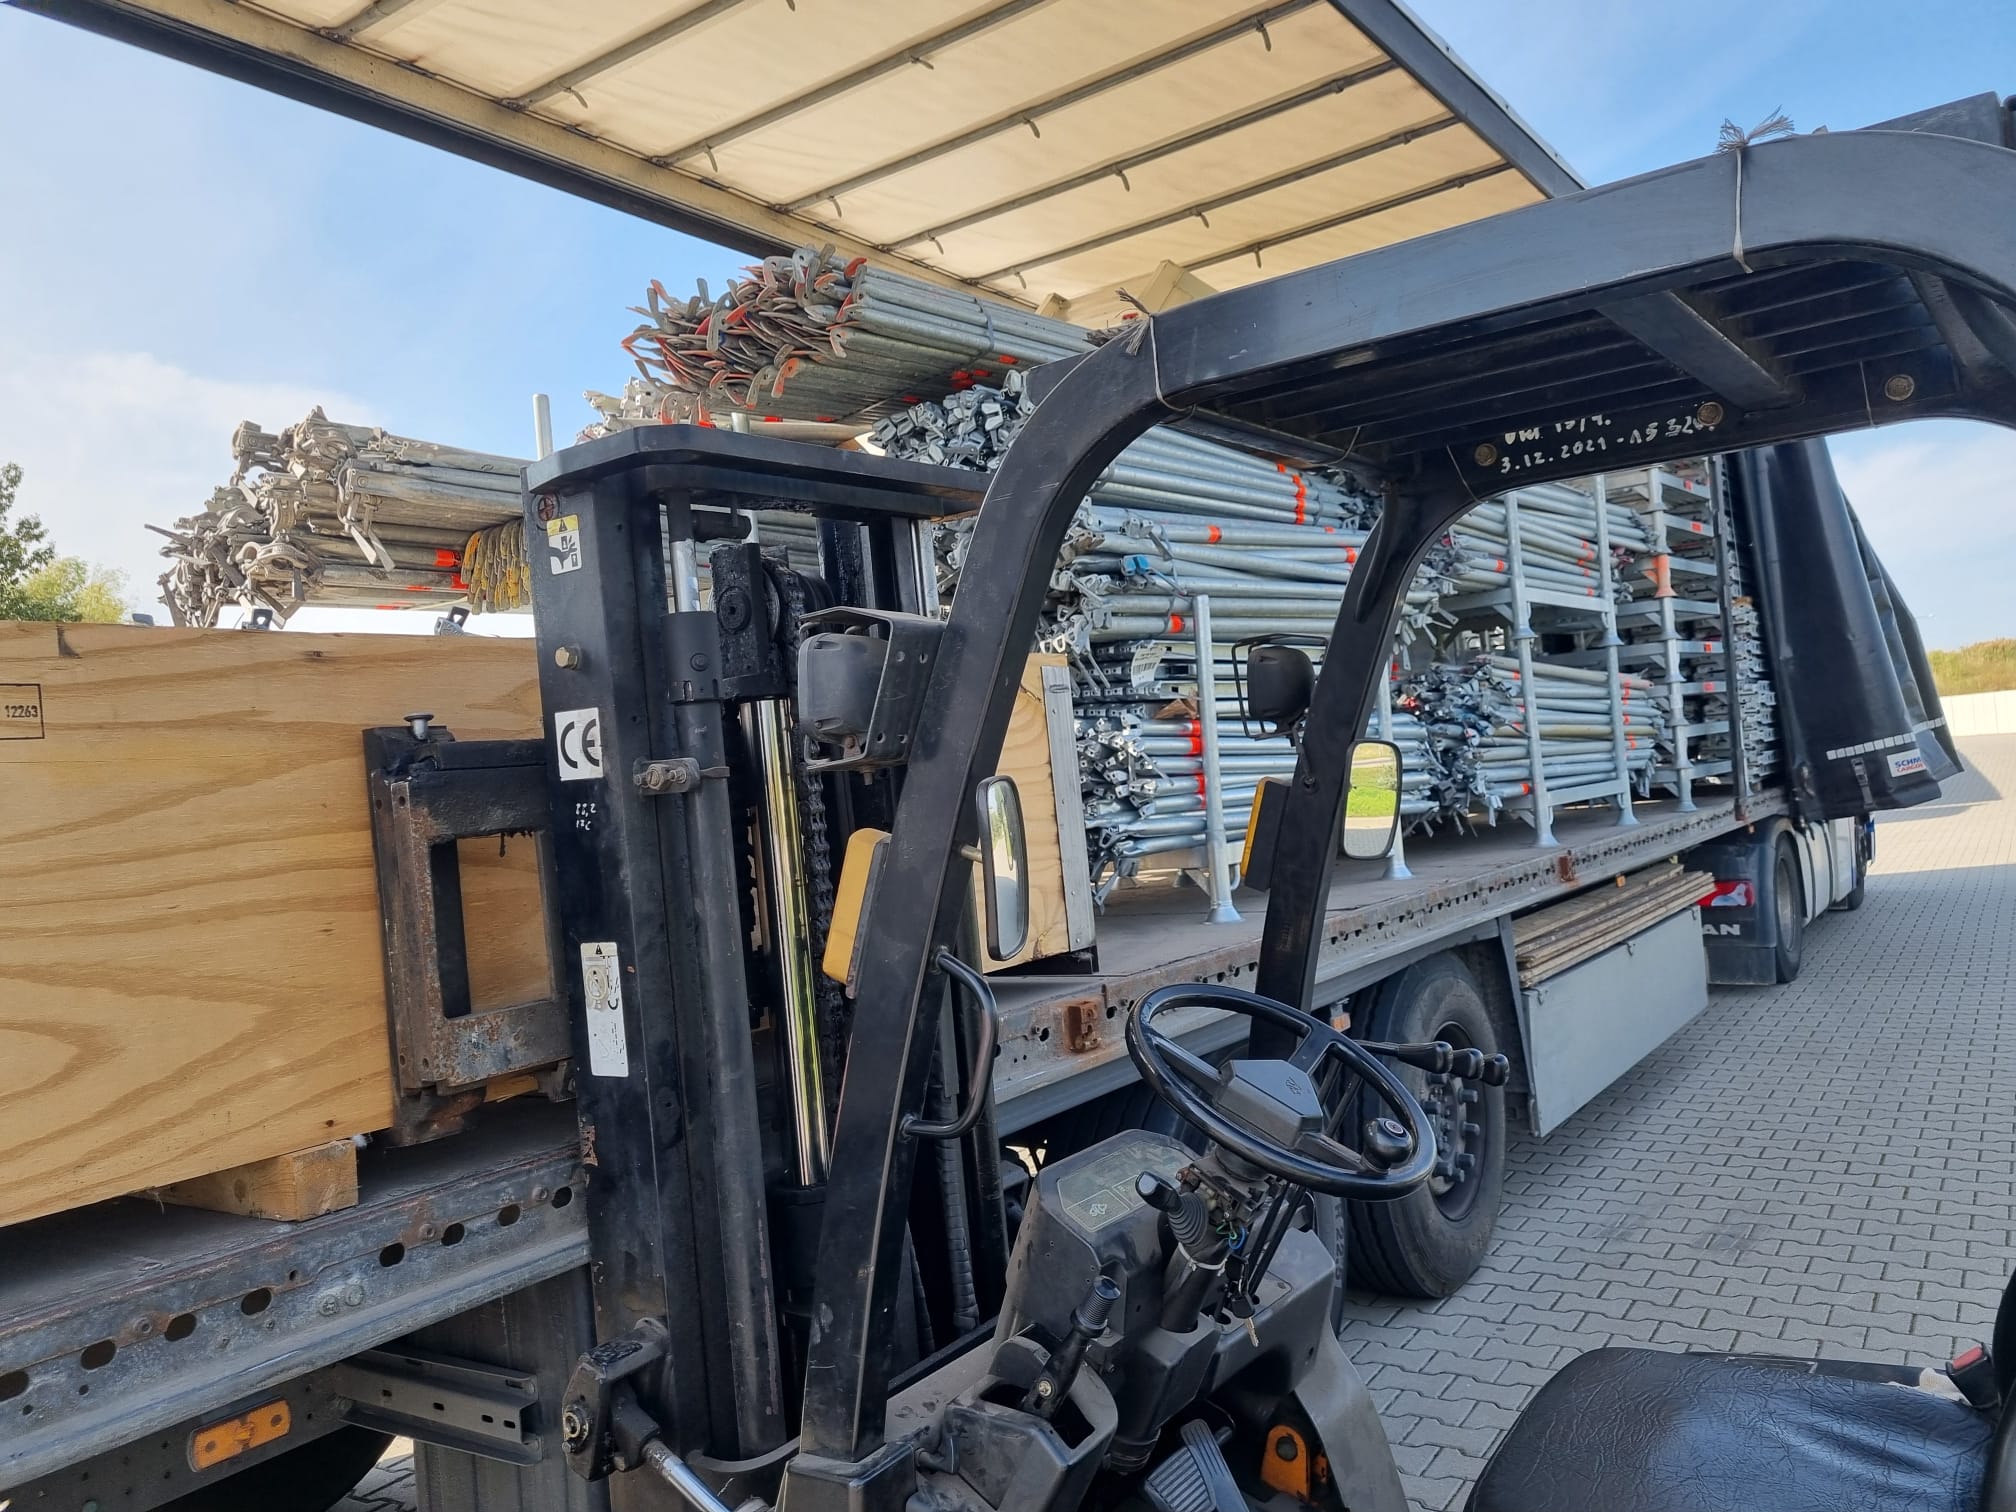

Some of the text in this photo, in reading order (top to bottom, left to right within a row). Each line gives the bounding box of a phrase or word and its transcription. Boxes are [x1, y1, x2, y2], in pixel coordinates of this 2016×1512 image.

[5, 705, 38, 718] 12263
[560, 719, 600, 769] CE
[1702, 924, 1741, 935] AN
